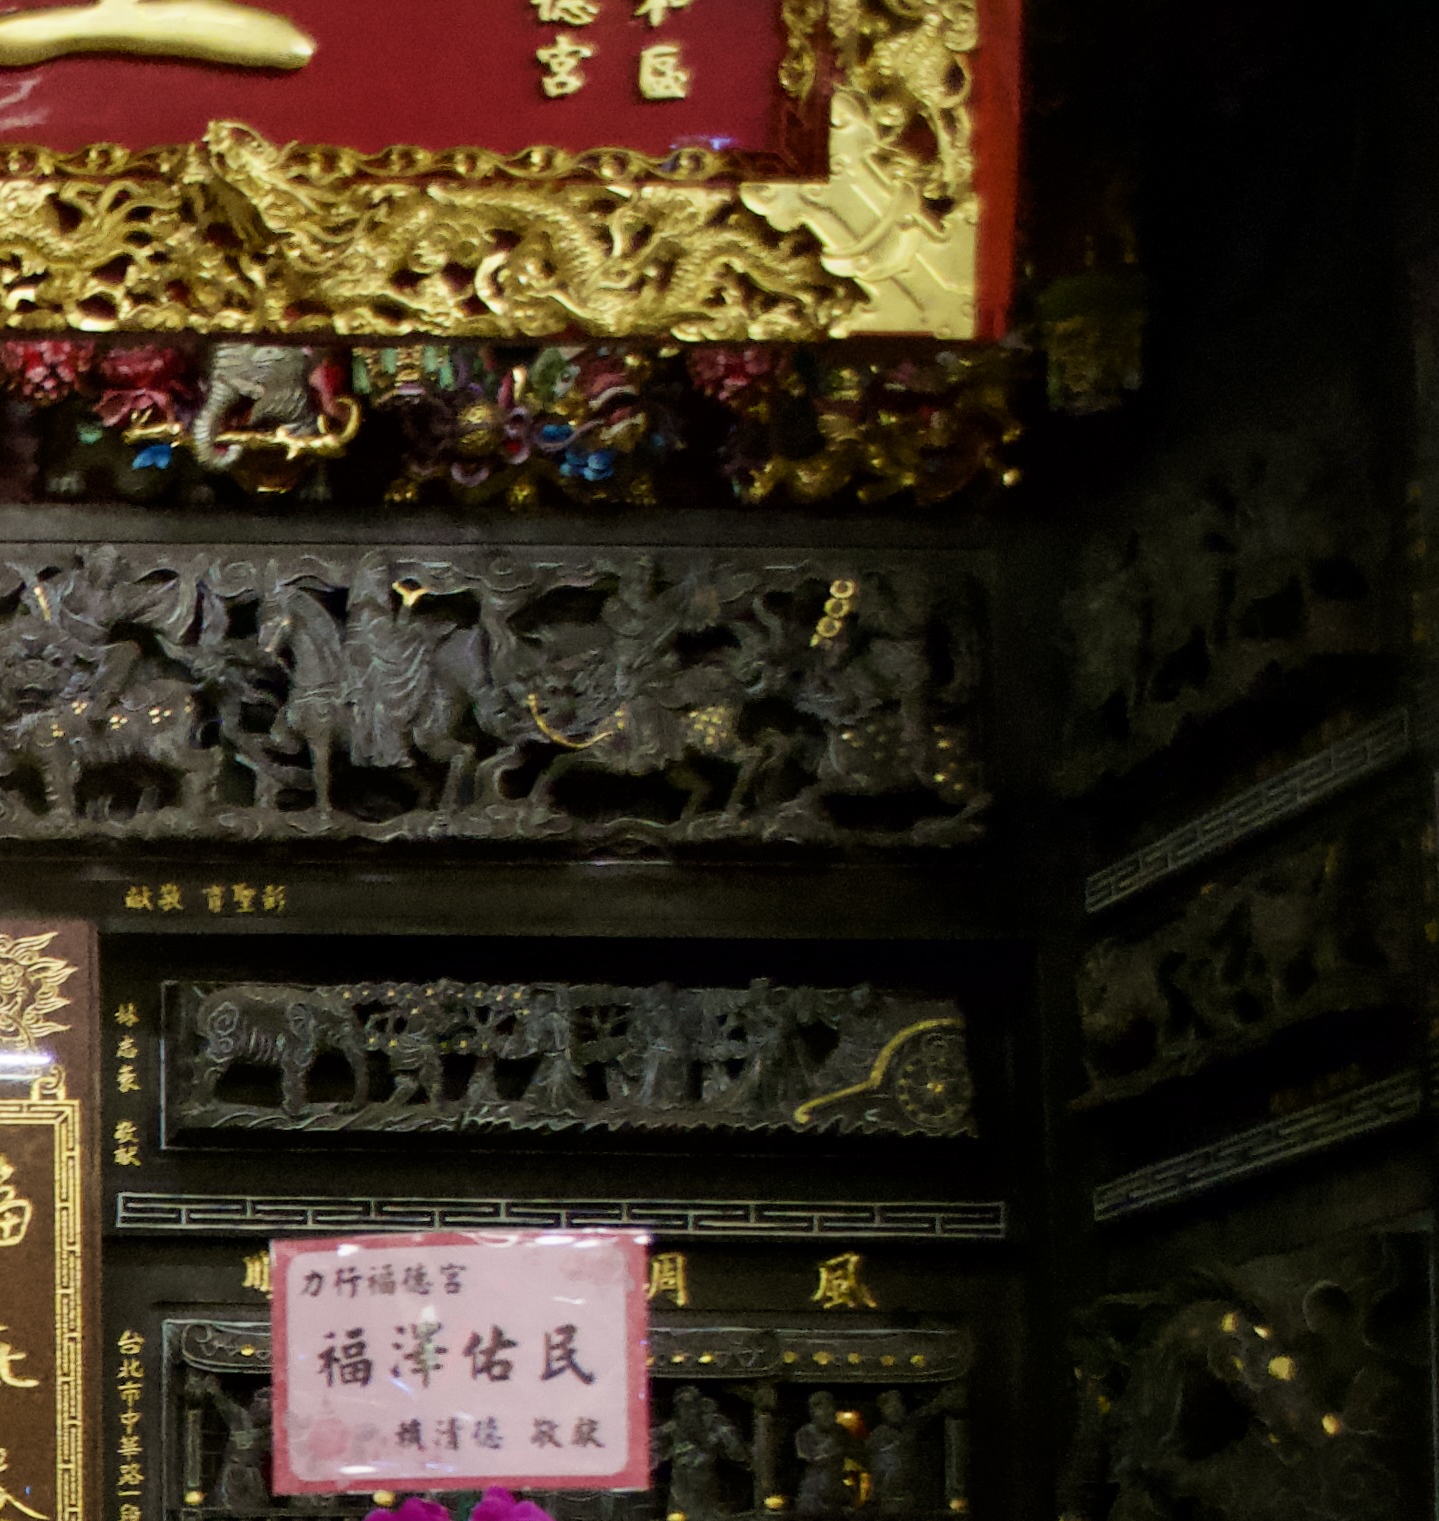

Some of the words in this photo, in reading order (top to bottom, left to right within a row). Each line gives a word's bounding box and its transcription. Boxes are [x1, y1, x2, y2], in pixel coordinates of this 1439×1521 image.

[299, 1262, 467, 1298] 力行福德宮
[317, 1321, 596, 1390] 福澤佑民
